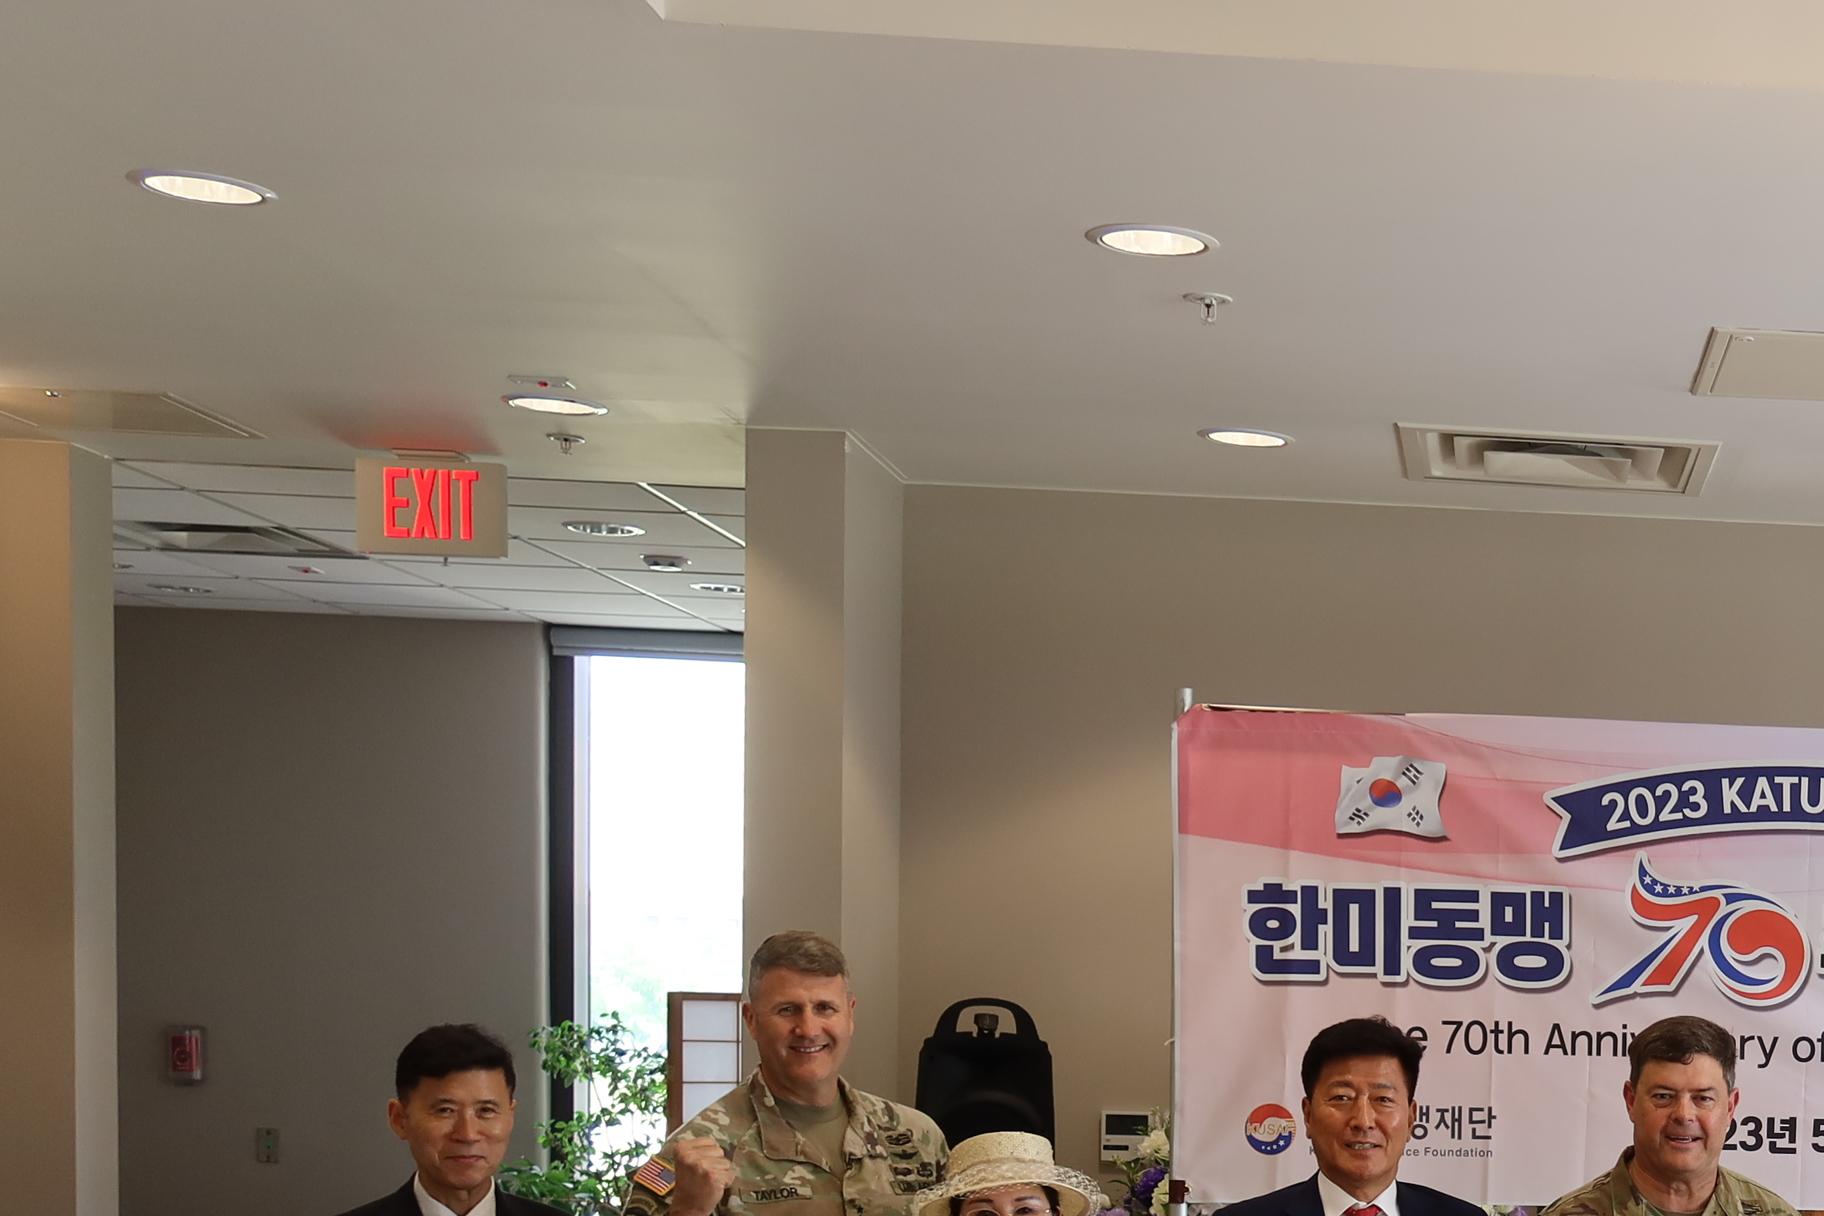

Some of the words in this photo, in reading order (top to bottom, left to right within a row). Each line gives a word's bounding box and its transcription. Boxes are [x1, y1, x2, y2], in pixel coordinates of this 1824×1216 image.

[383, 466, 480, 541] EXIT
[1601, 779, 1708, 832] 2023
[1245, 880, 1567, 984] 한미동맹
[1442, 1020, 1530, 1056] 70th
[1424, 1147, 1493, 1158] Foundation
[1722, 1116, 1797, 1154] 23년
[753, 1187, 799, 1201] TAYLOR
